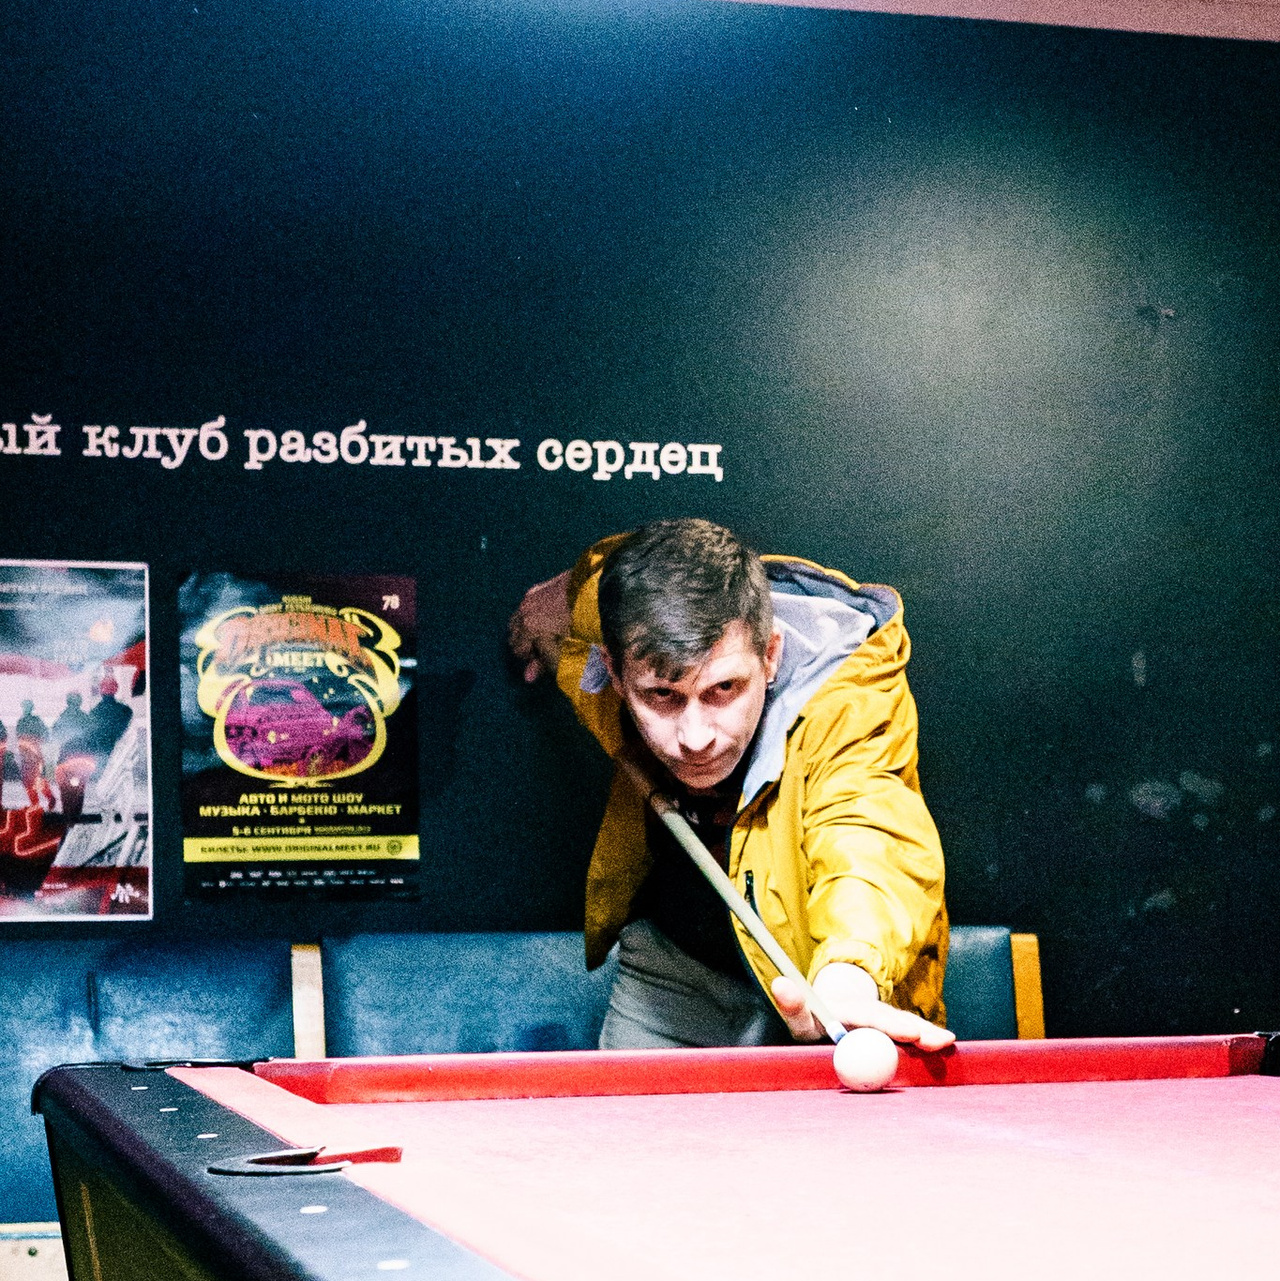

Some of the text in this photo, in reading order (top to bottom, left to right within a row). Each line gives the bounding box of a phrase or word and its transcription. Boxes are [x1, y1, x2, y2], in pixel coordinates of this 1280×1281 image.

[83, 416, 228, 470] клуб
[244, 420, 521, 470] разбитых
[537, 438, 723, 482] сердец
[239, 792, 363, 805] АВТО И МОТО ШОУ
[200, 804, 402, 817] МУЗЫКА БАРБЕКЮ МАРКЕТ
